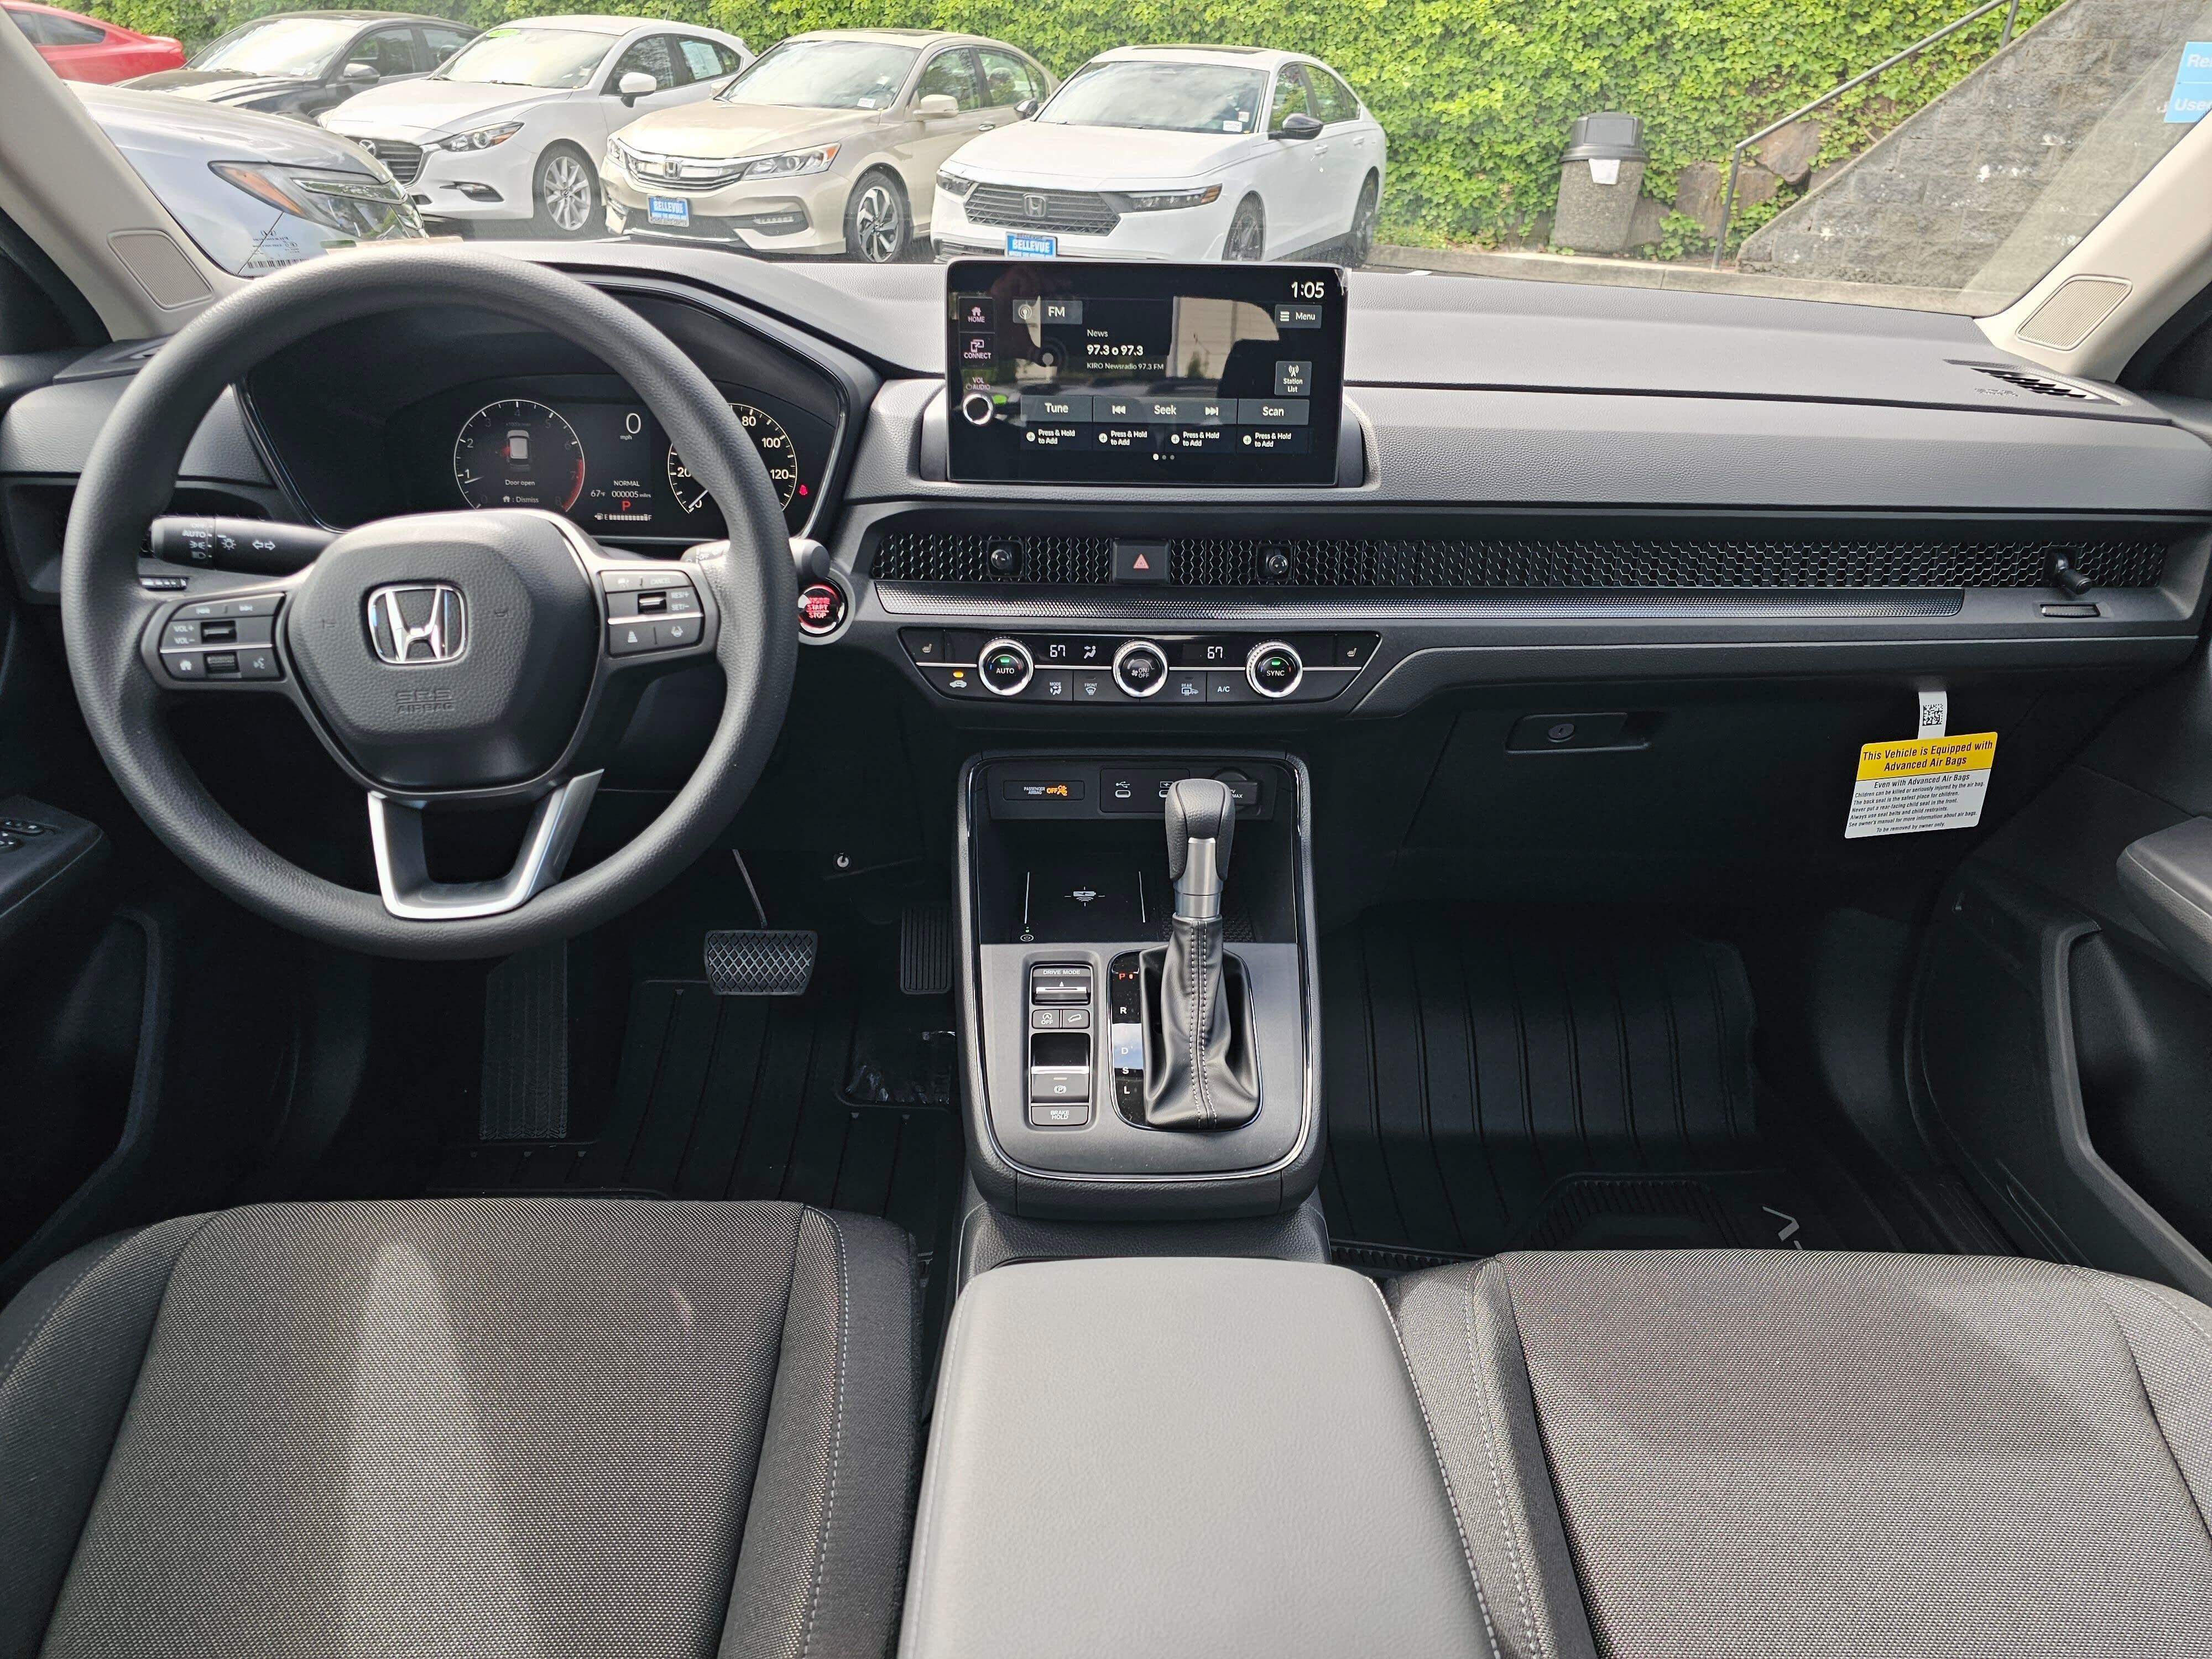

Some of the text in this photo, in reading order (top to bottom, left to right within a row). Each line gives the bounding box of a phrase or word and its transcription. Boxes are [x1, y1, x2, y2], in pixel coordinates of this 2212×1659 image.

[1013, 239, 1050, 253] BELLEVUE
[1291, 281, 1324, 299] 1:05
[1047, 306, 1065, 317] FM
[1296, 312, 1316, 320] Menu
[1087, 329, 1108, 337] News
[1087, 344, 1109, 356] 97.3
[1120, 345, 1144, 356] 97.3
[1045, 403, 1069, 413] Tune
[1154, 404, 1177, 415] Seek
[1262, 406, 1284, 416] Scan
[625, 413, 641, 434] 0
[742, 416, 757, 426] 80
[467, 438, 474, 448] 2
[761, 437, 781, 448] 100
[465, 469, 469, 478] 1
[770, 469, 789, 479] 120
[622, 500, 631, 512] P
[182, 530, 206, 538] AUTO
[1050, 645, 1066, 658] 67
[1207, 646, 1223, 659] 67
[1863, 740, 1992, 760] This Vehicle is Equipped with
[1884, 757, 1967, 771] Advanced Air Bags
[1908, 776, 1940, 785] Advanced
[1124, 1086, 1130, 1094] L
